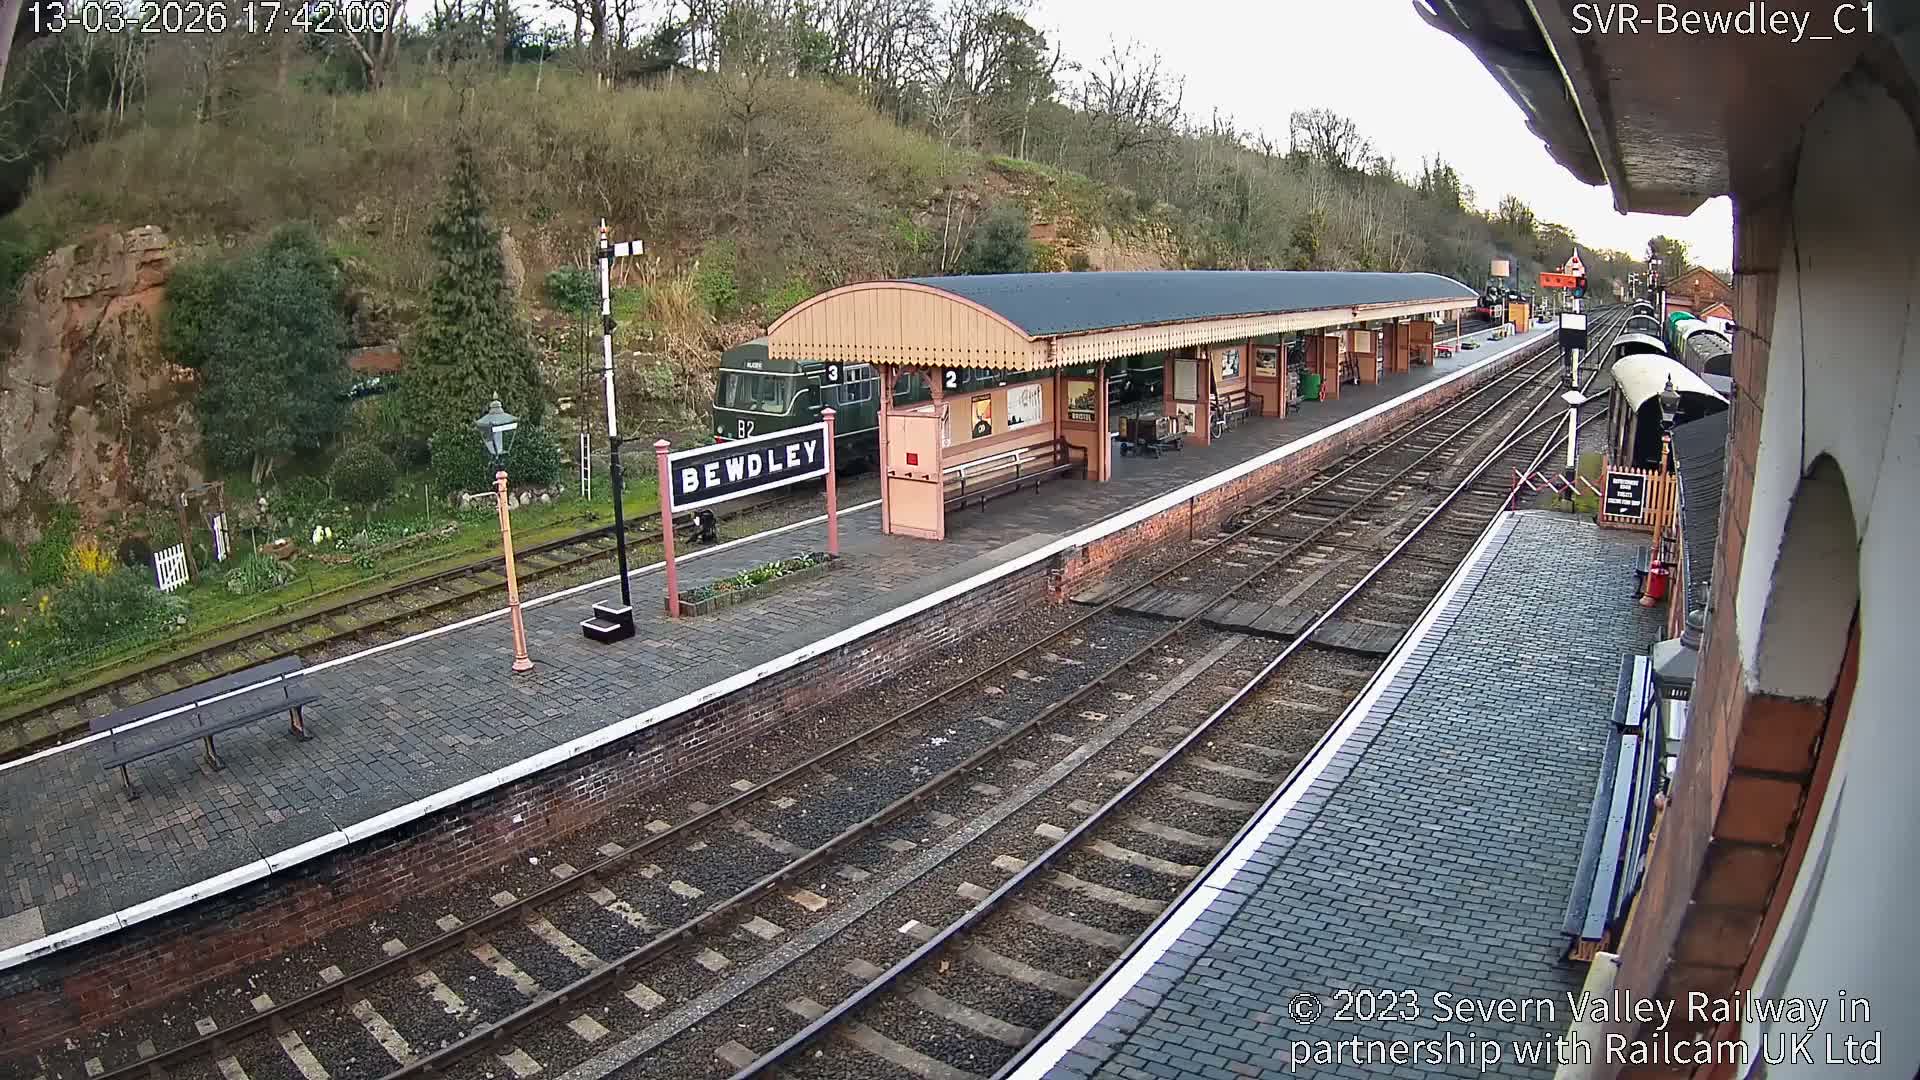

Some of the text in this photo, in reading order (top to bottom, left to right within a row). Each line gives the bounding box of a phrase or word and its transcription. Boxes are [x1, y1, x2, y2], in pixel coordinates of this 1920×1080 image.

[828, 365, 838, 381] 3
[945, 370, 957, 388] 2
[681, 439, 817, 494] BEWDLEY
